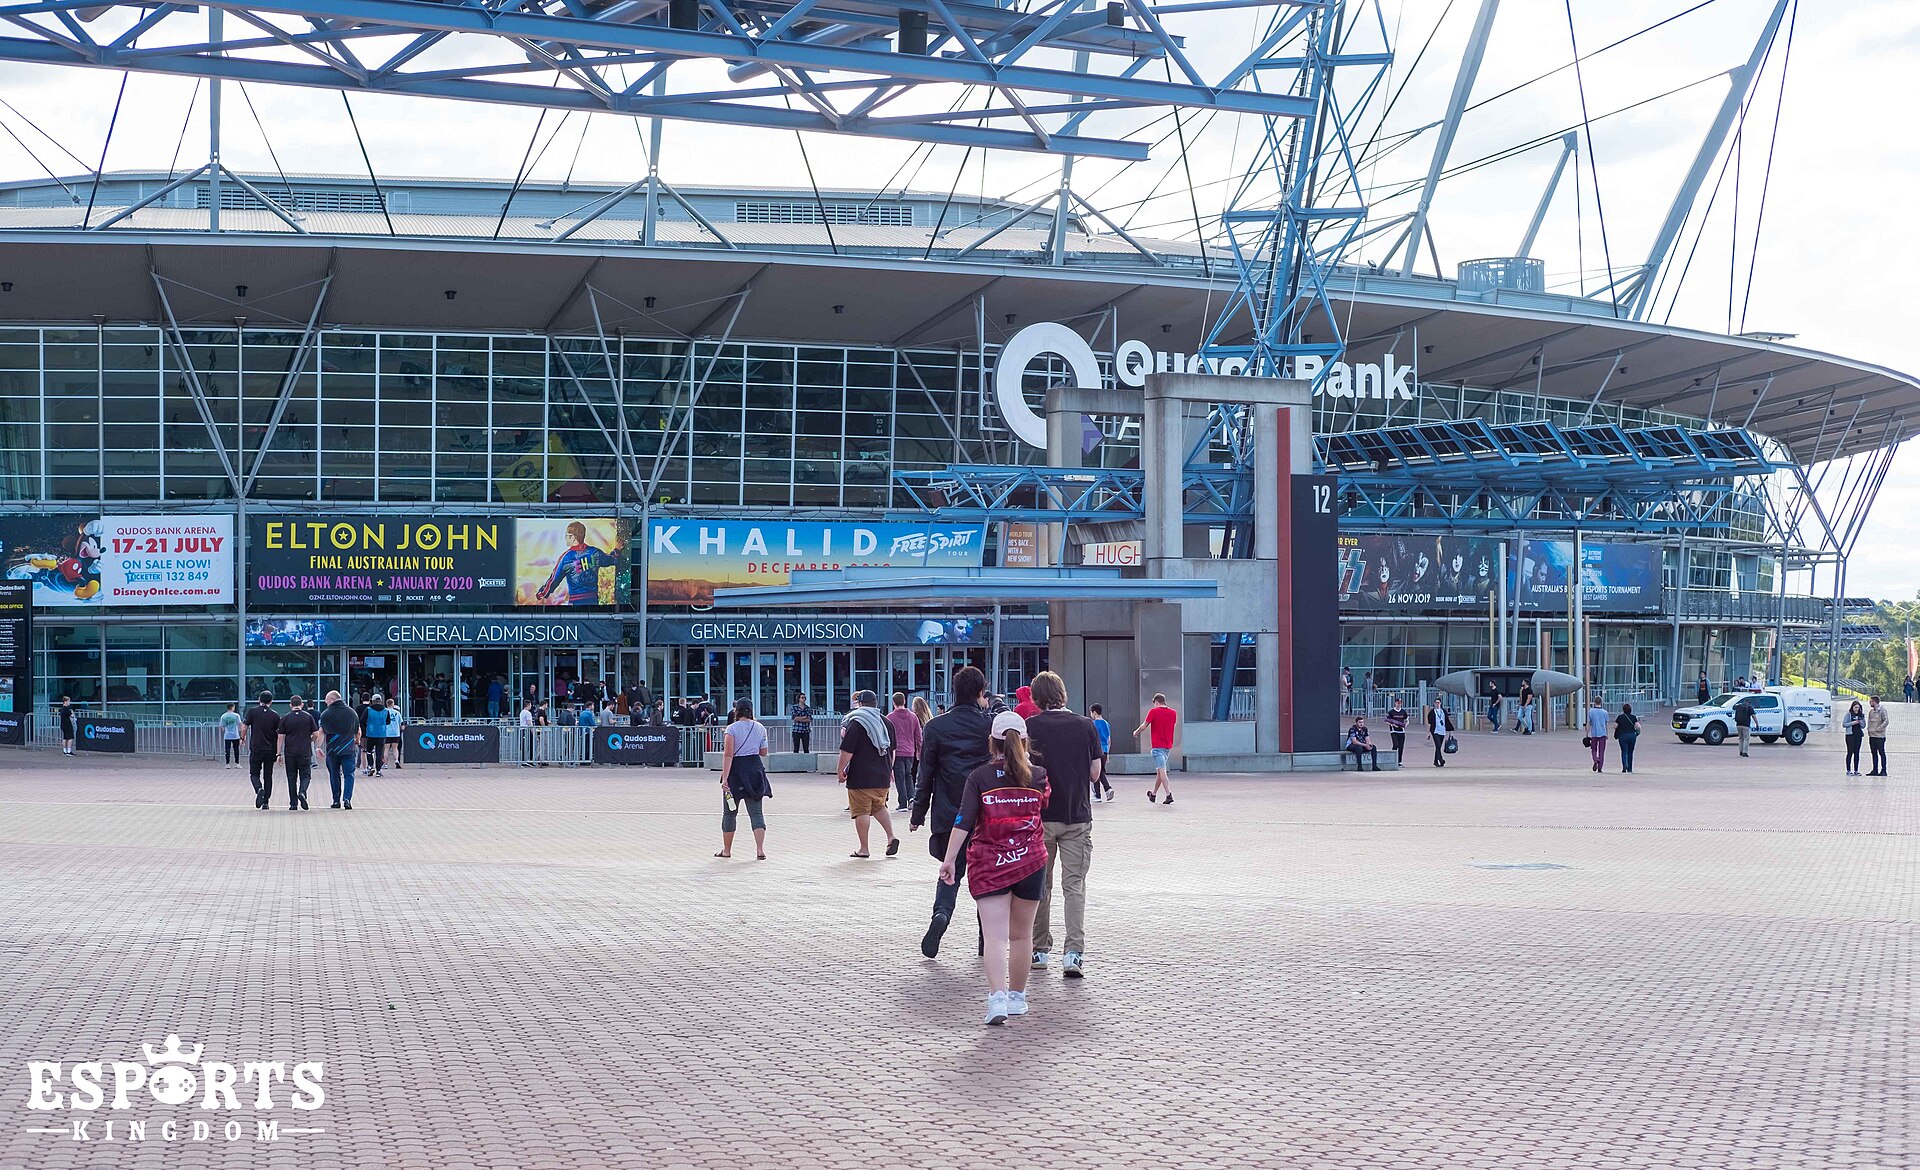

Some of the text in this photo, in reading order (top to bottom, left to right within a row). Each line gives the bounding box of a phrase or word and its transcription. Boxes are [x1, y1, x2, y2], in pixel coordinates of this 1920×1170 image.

[1295, 353, 1414, 401] Bank
[1313, 485, 1331, 513] 12
[117, 527, 216, 535] QUDOS BANK ARENA
[266, 522, 498, 551] ELTON JOHN
[112, 538, 224, 553] 17-21 JULY
[654, 526, 978, 557] KHALID FREE SPIRIT
[1344, 538, 1358, 546] EVER
[122, 560, 211, 570] ON SALE NOW!
[310, 555, 454, 570] FINAL AUSTRALIAN TOUR
[166, 572, 185, 581] 132
[189, 572, 209, 581] 849
[258, 575, 297, 590] QUDOS
[300, 575, 331, 590] BANK
[335, 576, 373, 590] ARENA
[388, 576, 440, 590] JANUARY
[443, 576, 473, 590] 2020
[113, 587, 221, 598] DisneyOnIce.com.au
[1531, 584, 1564, 593] AUSTRALIA'S
[1585, 585, 1608, 594] ESPORTS
[1608, 586, 1642, 594] TOURNAMENT
[1388, 593, 1396, 604] 26
[1397, 593, 1414, 604] NOV
[1414, 593, 1431, 604] 2019
[387, 625, 579, 642] GENERAL ADMISSION
[691, 623, 864, 639] GENERAL ADMISSION
[982, 795, 1039, 807] Champion
